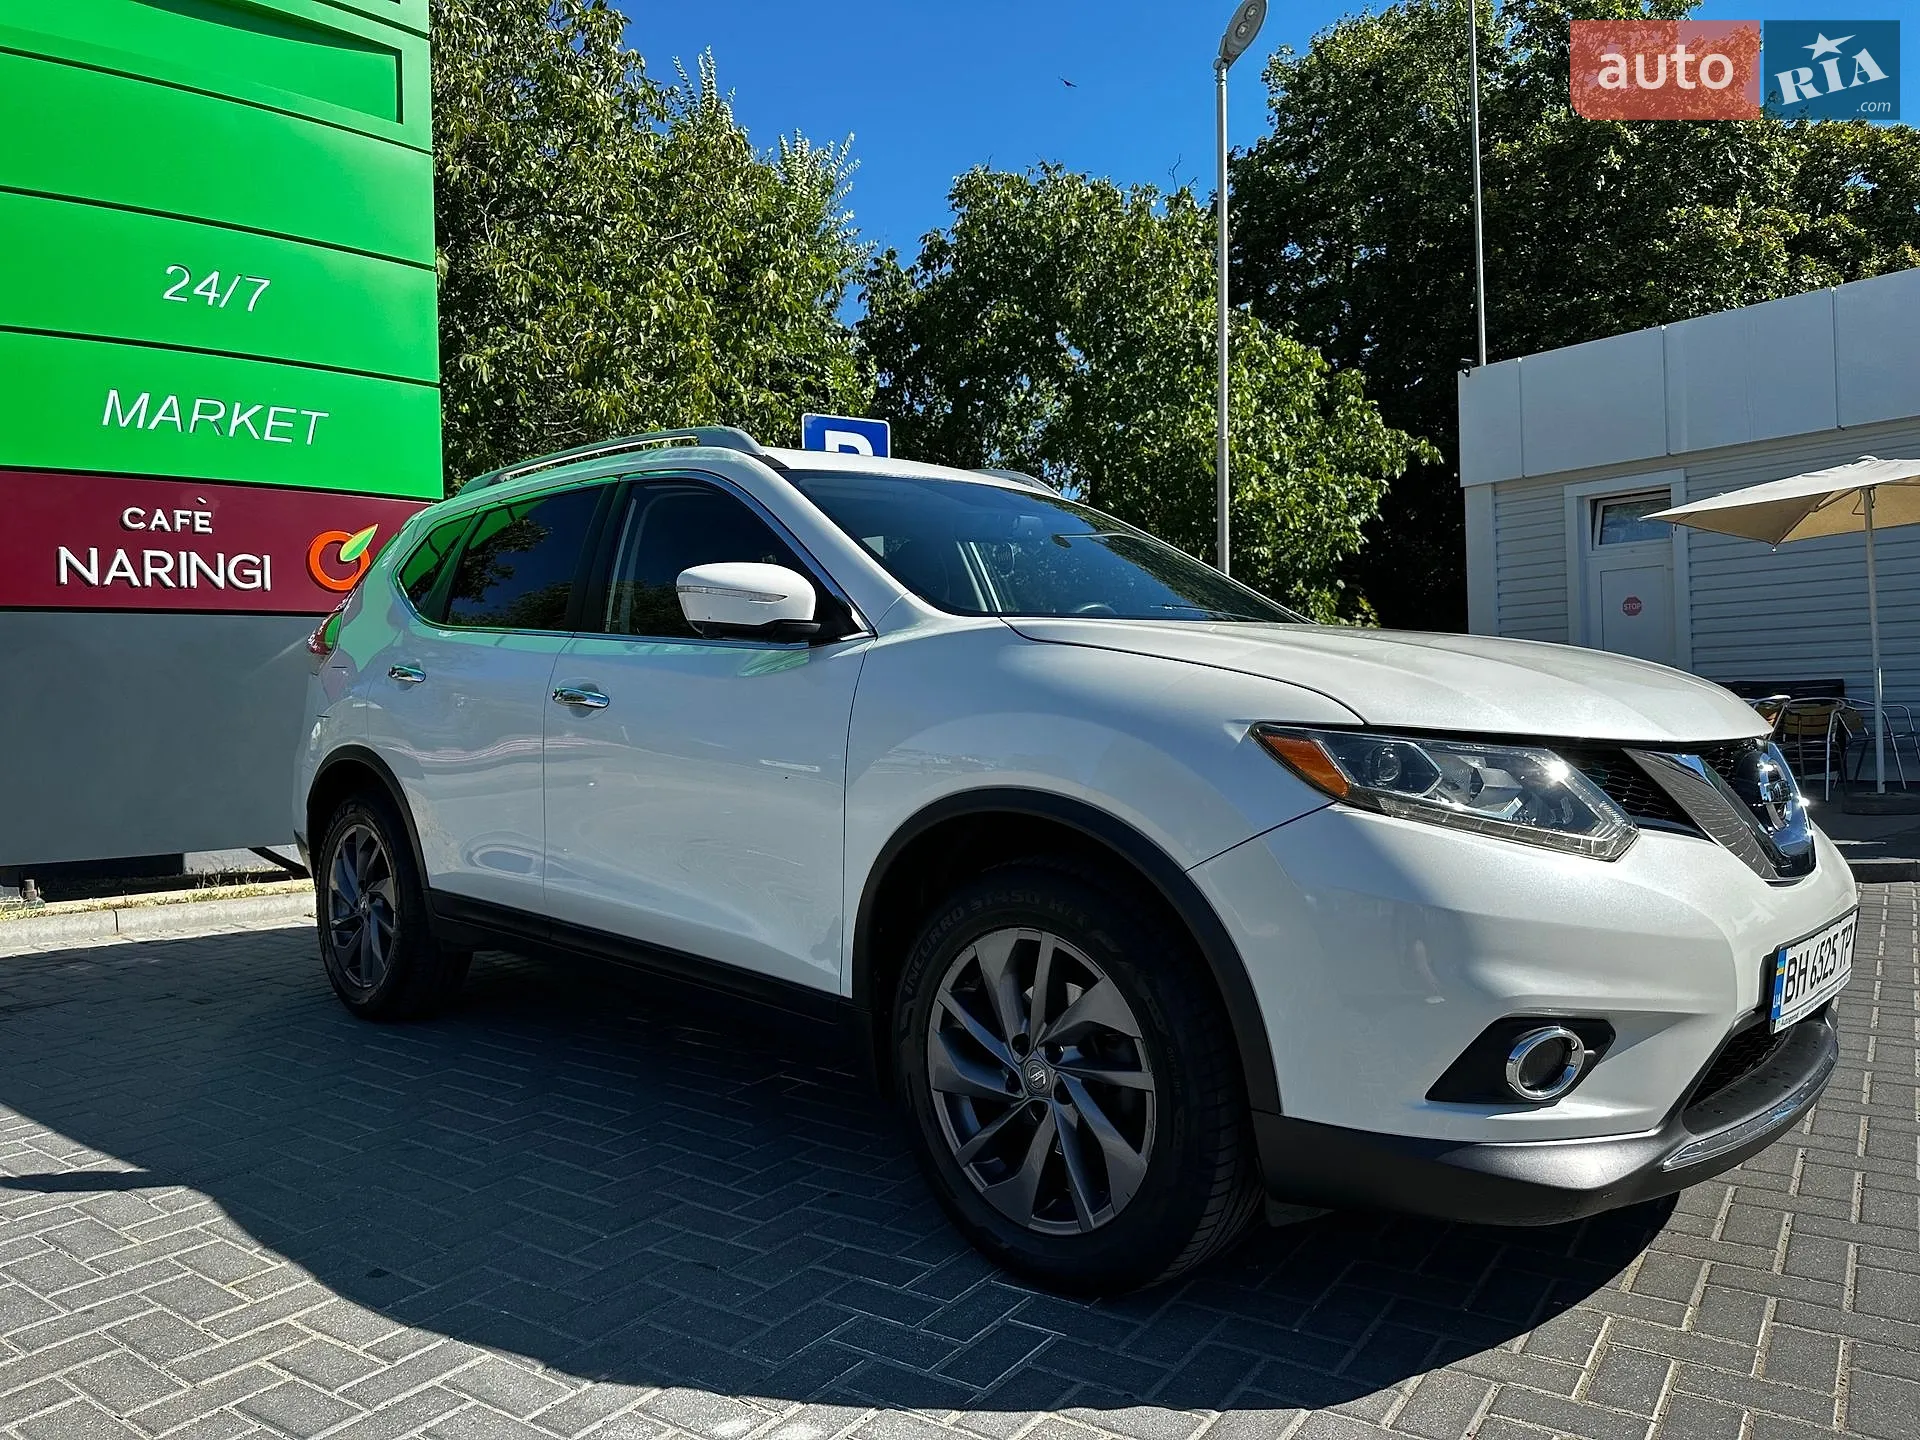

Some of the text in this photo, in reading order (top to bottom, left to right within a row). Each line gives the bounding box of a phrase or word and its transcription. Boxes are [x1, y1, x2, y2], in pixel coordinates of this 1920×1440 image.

[162, 264, 272, 312] 24/7
[102, 389, 330, 446] MARKET
[121, 497, 213, 534] CAFÈ
[58, 546, 272, 592] NARINGI
[1783, 950, 1810, 1005] BH
[1810, 933, 1838, 990] 6525
[1840, 923, 1853, 969] TP
